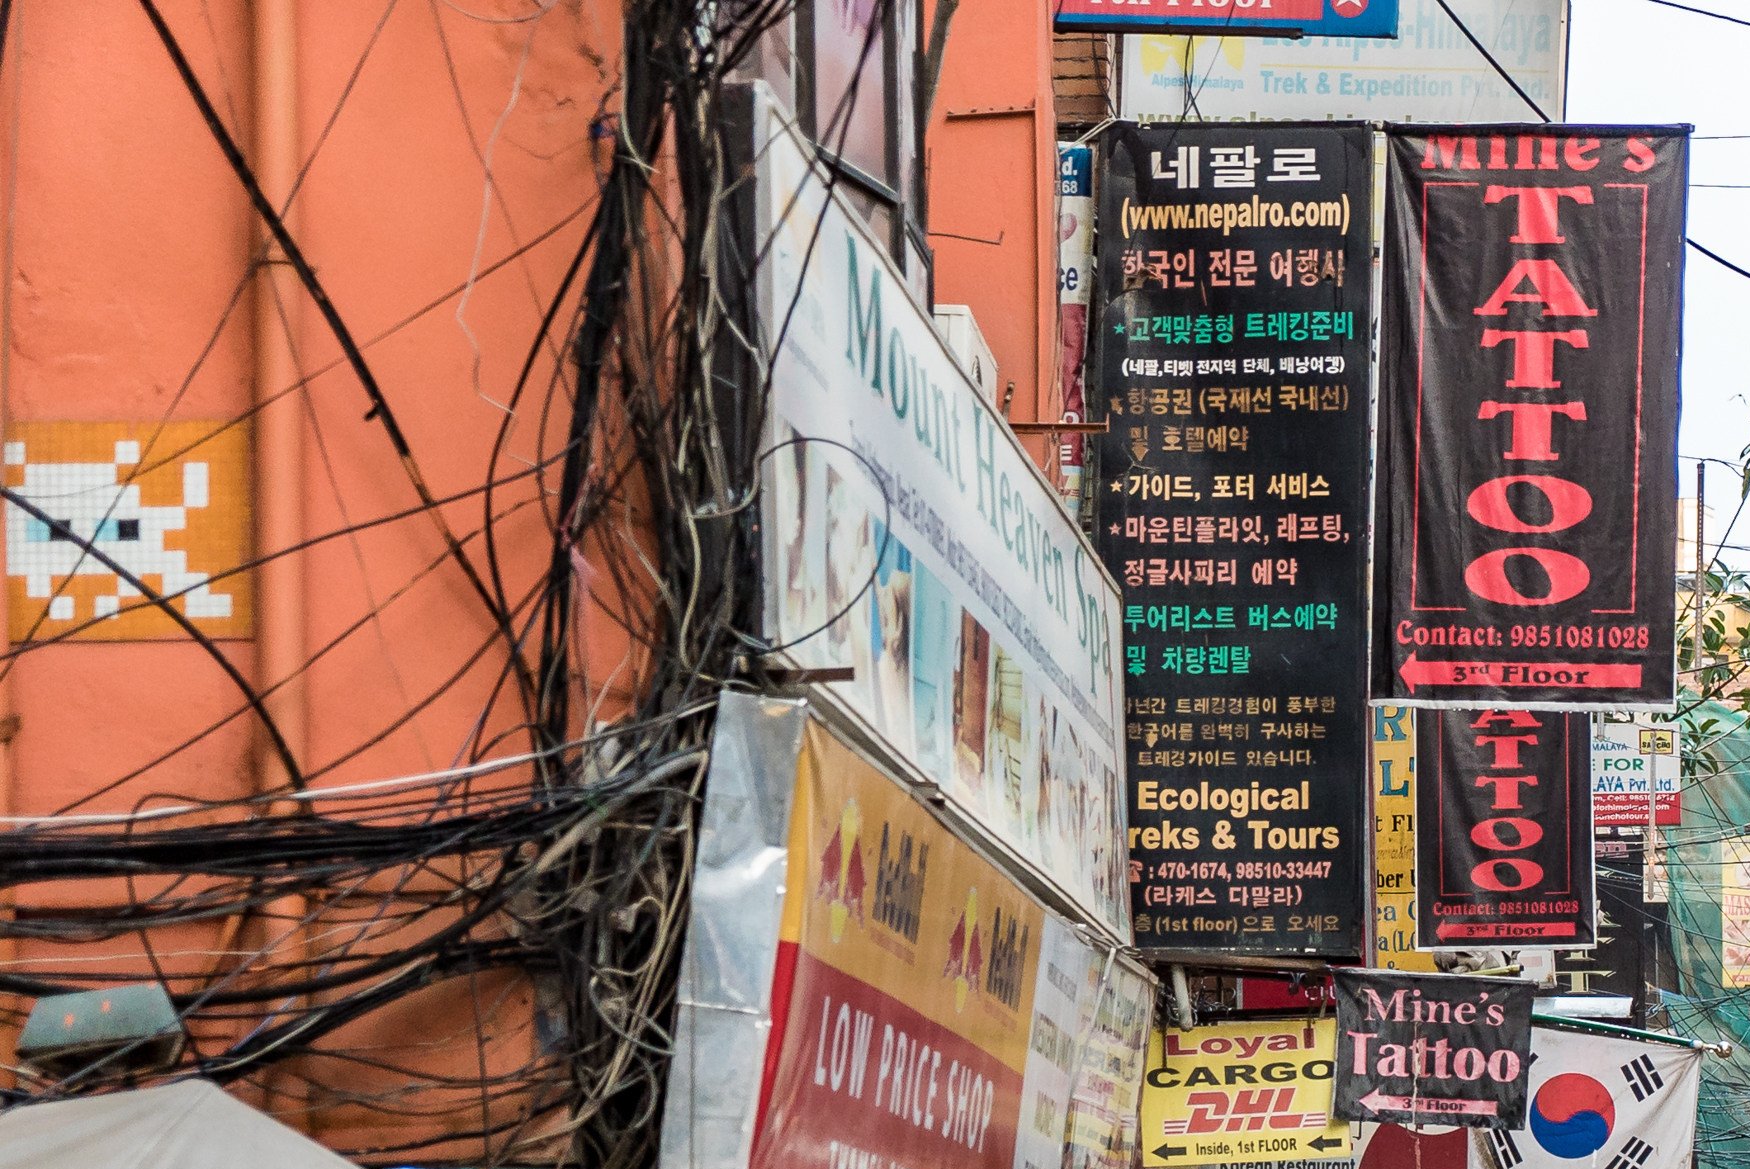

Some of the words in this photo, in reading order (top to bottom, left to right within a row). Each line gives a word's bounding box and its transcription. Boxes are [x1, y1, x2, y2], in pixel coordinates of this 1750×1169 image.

[1260, 71, 1312, 96] Trek
[1339, 70, 1452, 101] Expedition
[1151, 145, 1321, 189] 네팔로
[1121, 194, 1350, 239] (www.nepalro.com)
[1121, 249, 1195, 289] 한국인
[1208, 249, 1258, 287] 전문
[1270, 248, 1346, 287] 여행사
[1128, 314, 1234, 344] 고객맞춤형
[1244, 311, 1354, 342] 트레킹준비
[1127, 387, 1192, 415] 항공권
[1199, 385, 1272, 415] (국제선
[1278, 385, 1350, 412] 국내선)
[1464, 185, 1599, 606] TATTOO
[1162, 426, 1249, 452] 호텔예약
[1128, 473, 1201, 501] 가이드,
[1211, 473, 1254, 501] 포터
[1266, 472, 1330, 500] 서비스
[1125, 514, 1270, 545] 마운틴플라잇,
[1277, 513, 1350, 544] 래프팅,
[1123, 558, 1238, 587] 정글사파리
[1251, 558, 1298, 586] 예약
[1124, 605, 1236, 634] 투어리스트
[1248, 602, 1338, 631] 버스예약
[1396, 620, 1503, 648] Contact:
[1510, 625, 1649, 649] 9851081028
[1161, 645, 1251, 674] 차량렌탈
[1452, 663, 1490, 685] 3rd
[1502, 664, 1590, 685] Floor
[1604, 758, 1644, 771] FOR
[1137, 781, 1310, 818] Ecological
[1211, 820, 1236, 851] &
[1247, 820, 1340, 850] Tours
[1157, 862, 1232, 882] 470-1674,
[1235, 861, 1332, 880] 98510-33447
[1433, 901, 1493, 916] Contact:
[1499, 900, 1579, 915] 9851081028
[1193, 915, 1238, 933] floor)
[1494, 924, 1545, 936] Floor
[1362, 989, 1504, 1027] Mine's
[1166, 1028, 1315, 1063] Loyal
[1347, 1032, 1520, 1083] Tattoo
[815, 997, 874, 1100] LOW
[875, 1024, 943, 1131] PRICE
[941, 1060, 995, 1155] SHOP
[1146, 1060, 1334, 1089] CARGO
[1186, 1087, 1304, 1135] DHL
[1426, 1100, 1467, 1112] Floor
[1196, 1142, 1234, 1157] Inside,
[1238, 1141, 1255, 1154] 1st
[1258, 1138, 1297, 1153] FLOOR
